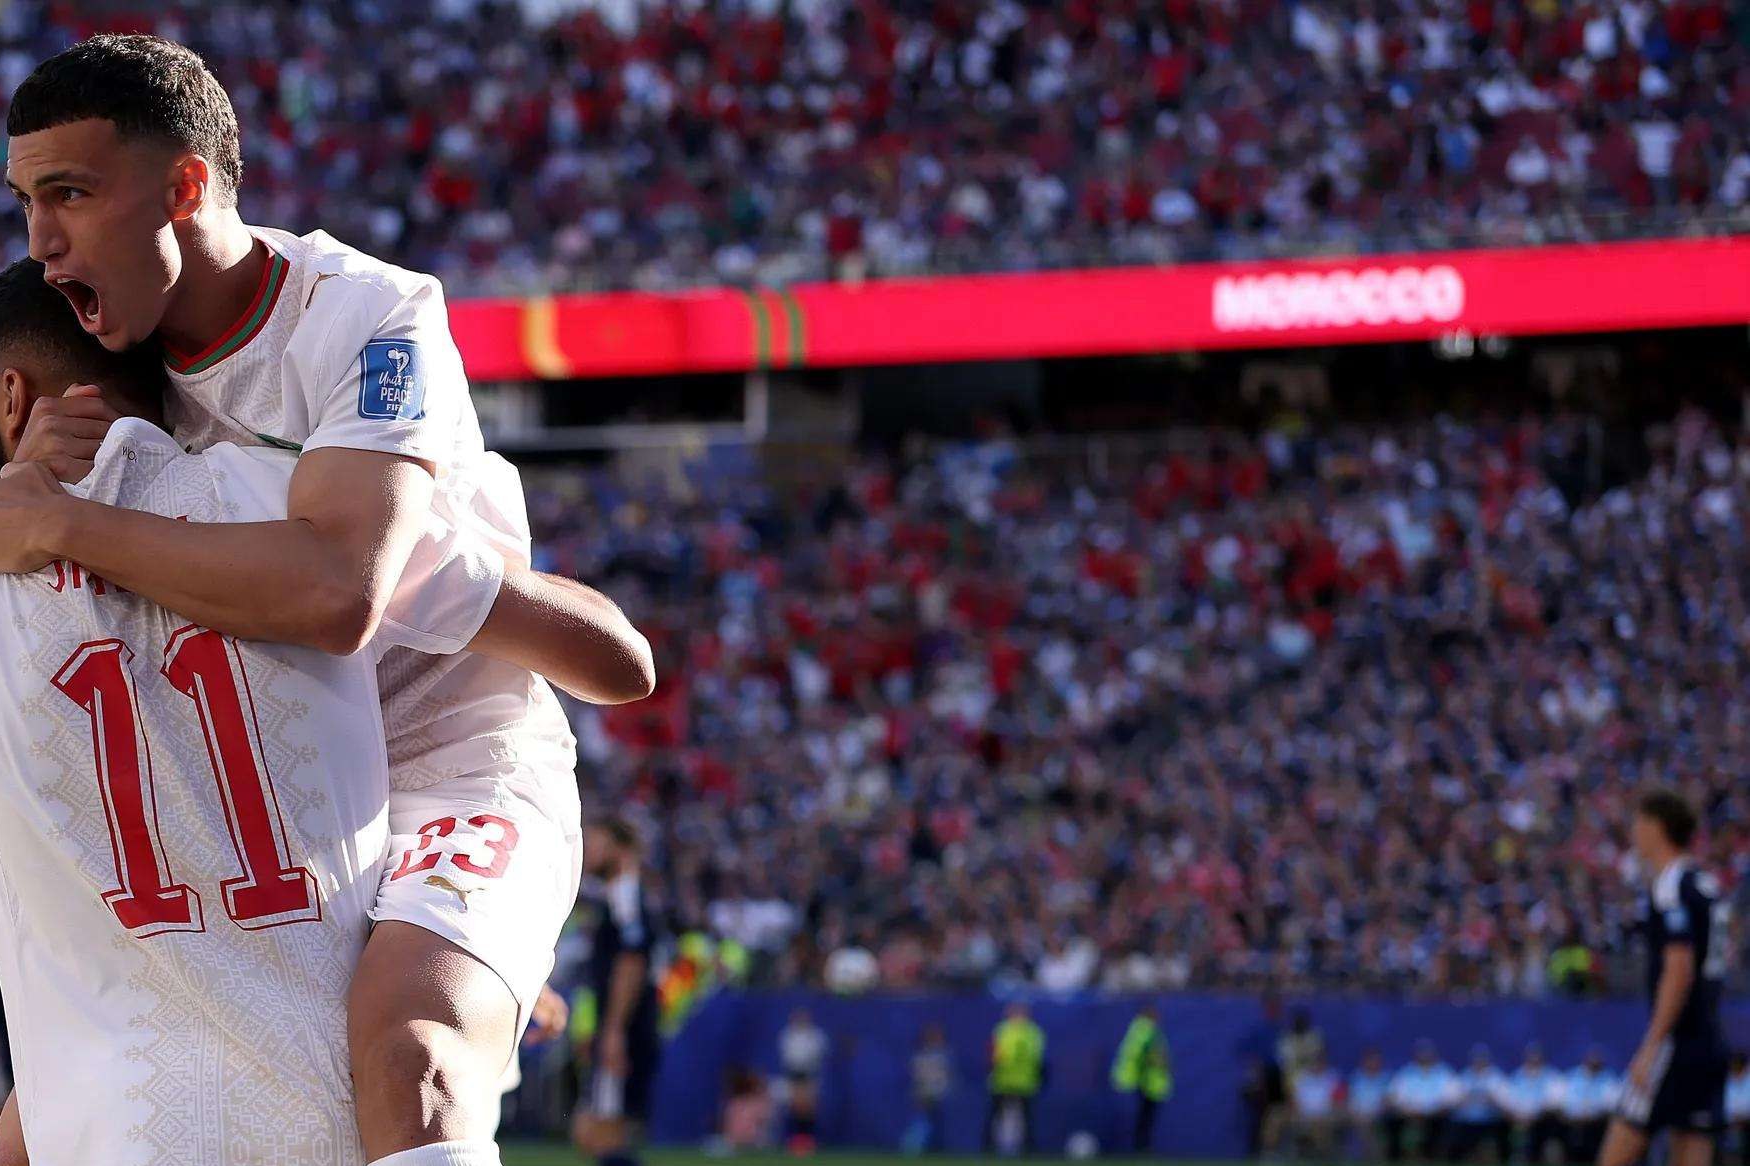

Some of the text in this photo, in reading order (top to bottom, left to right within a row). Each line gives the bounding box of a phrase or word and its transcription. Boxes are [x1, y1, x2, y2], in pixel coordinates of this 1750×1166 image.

[1212, 264, 1465, 332] MOROCCO
[50, 623, 323, 940] 11
[390, 813, 520, 881] 23
